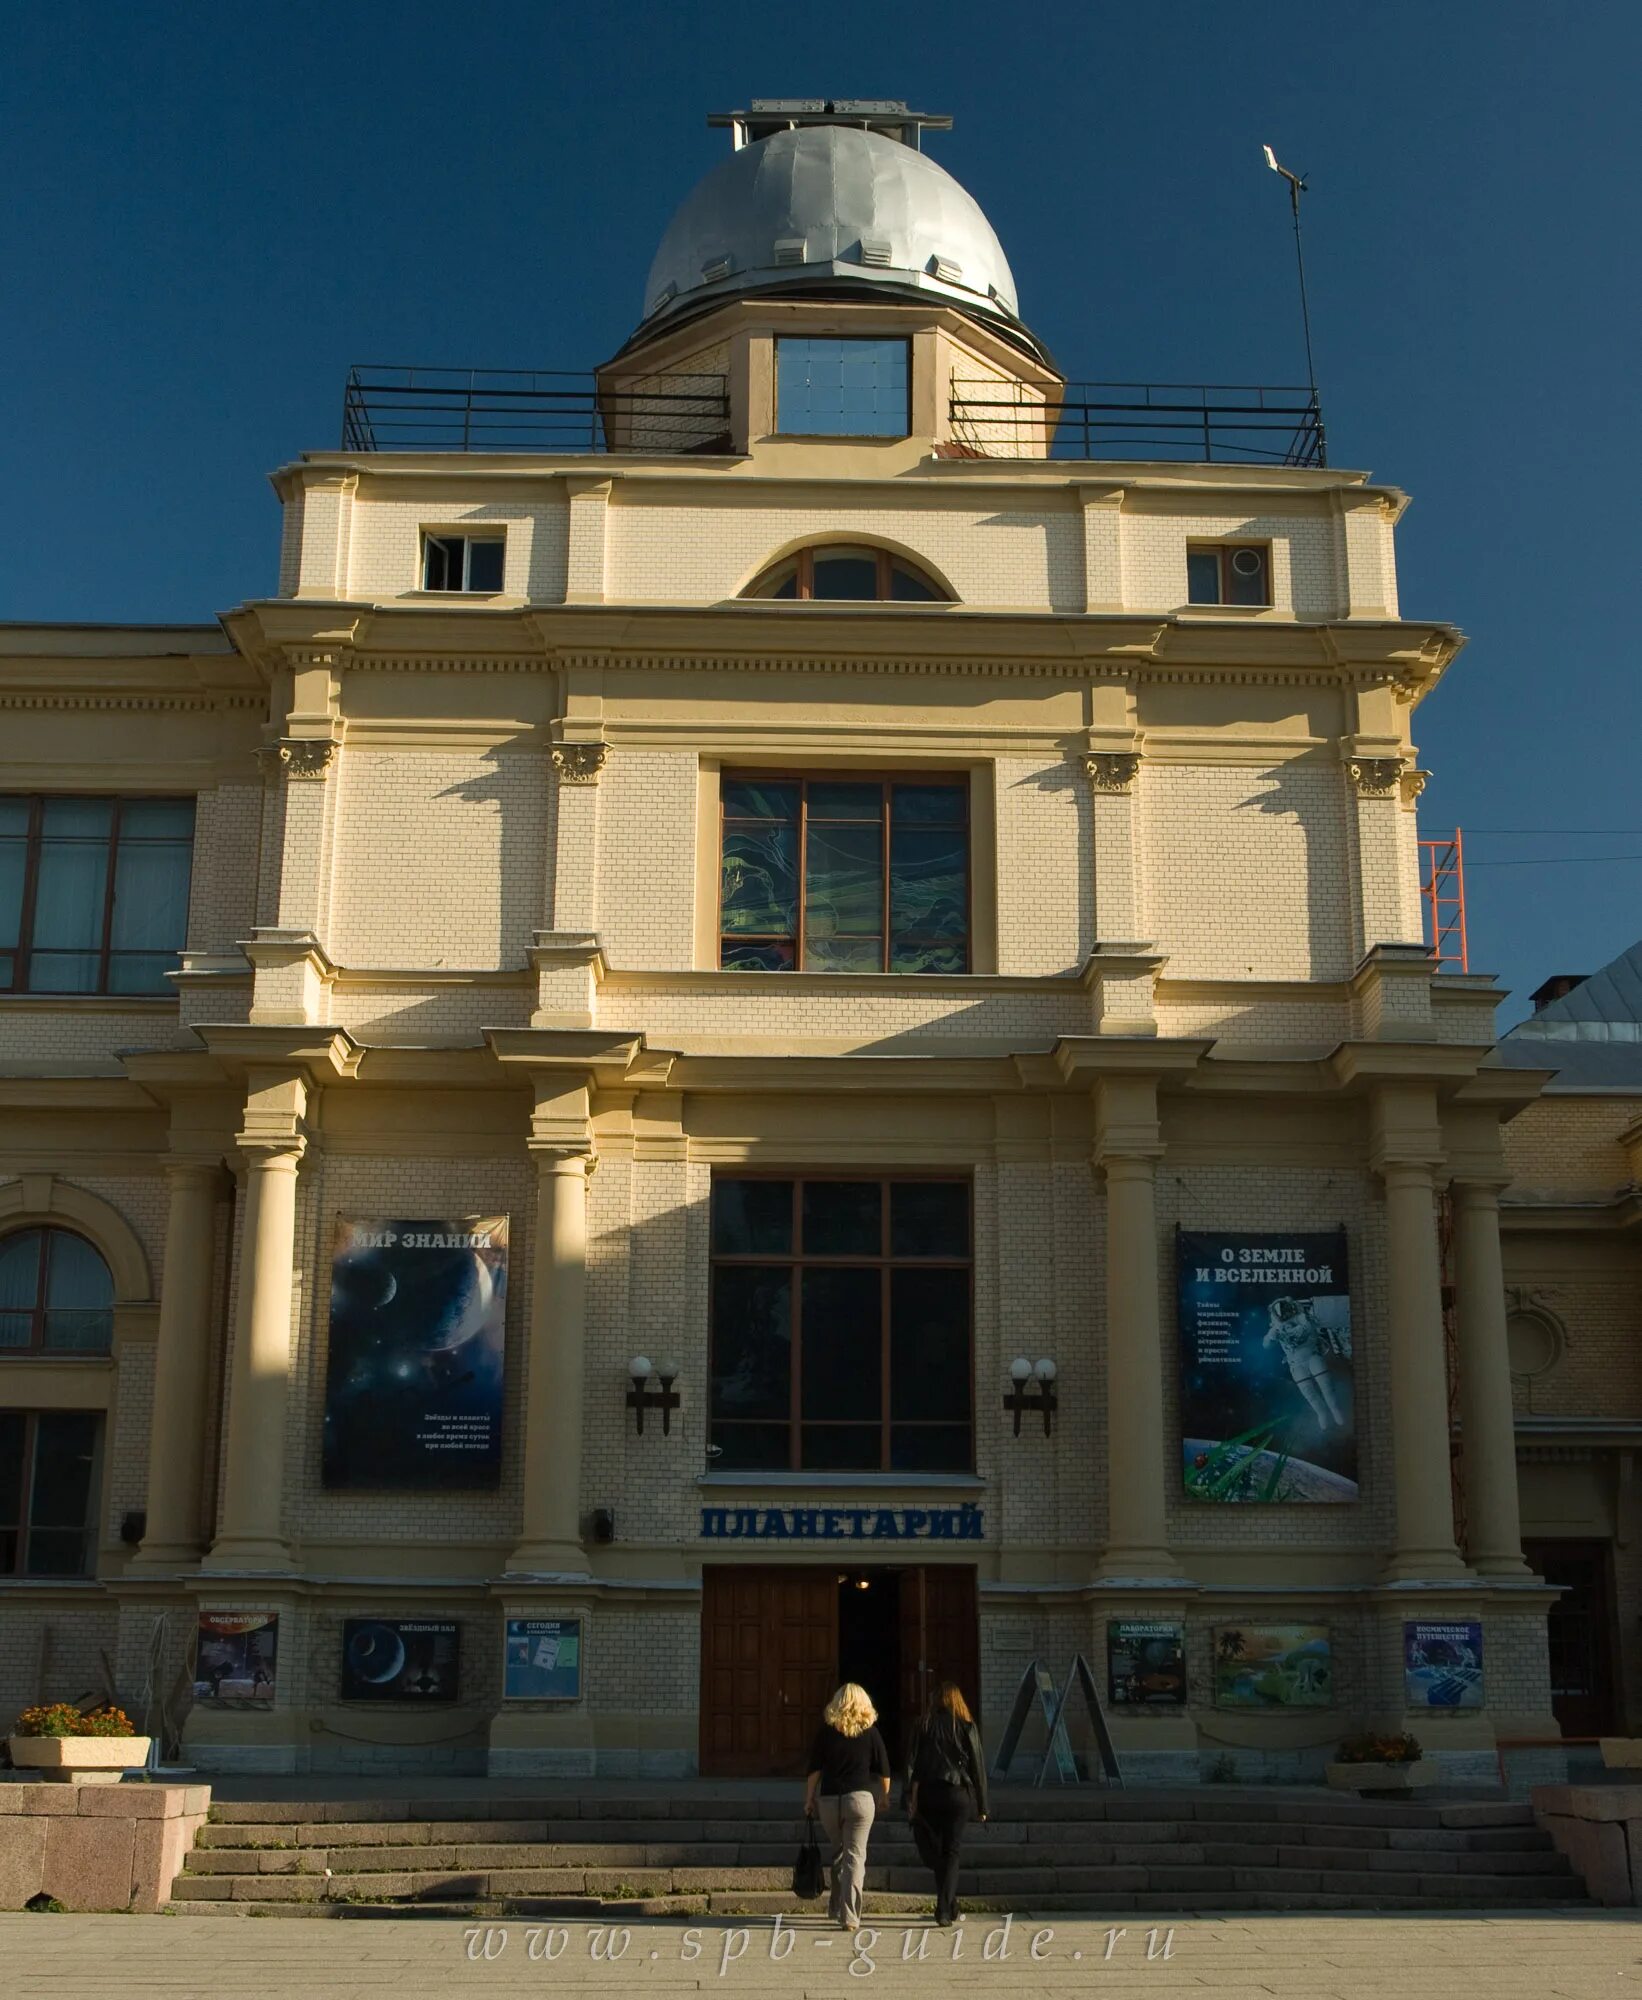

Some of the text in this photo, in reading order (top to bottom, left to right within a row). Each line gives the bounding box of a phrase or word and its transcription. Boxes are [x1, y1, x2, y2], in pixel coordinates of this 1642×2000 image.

[352, 1230, 492, 1248] МИР ЗНАНИЙ
[1221, 1249, 1305, 1263] О ЗЕМЛЕ
[1195, 1265, 1333, 1283] И ВСЕЛЕННОЙ
[701, 1503, 984, 1539] ПЛАНЕТАРИЙ
